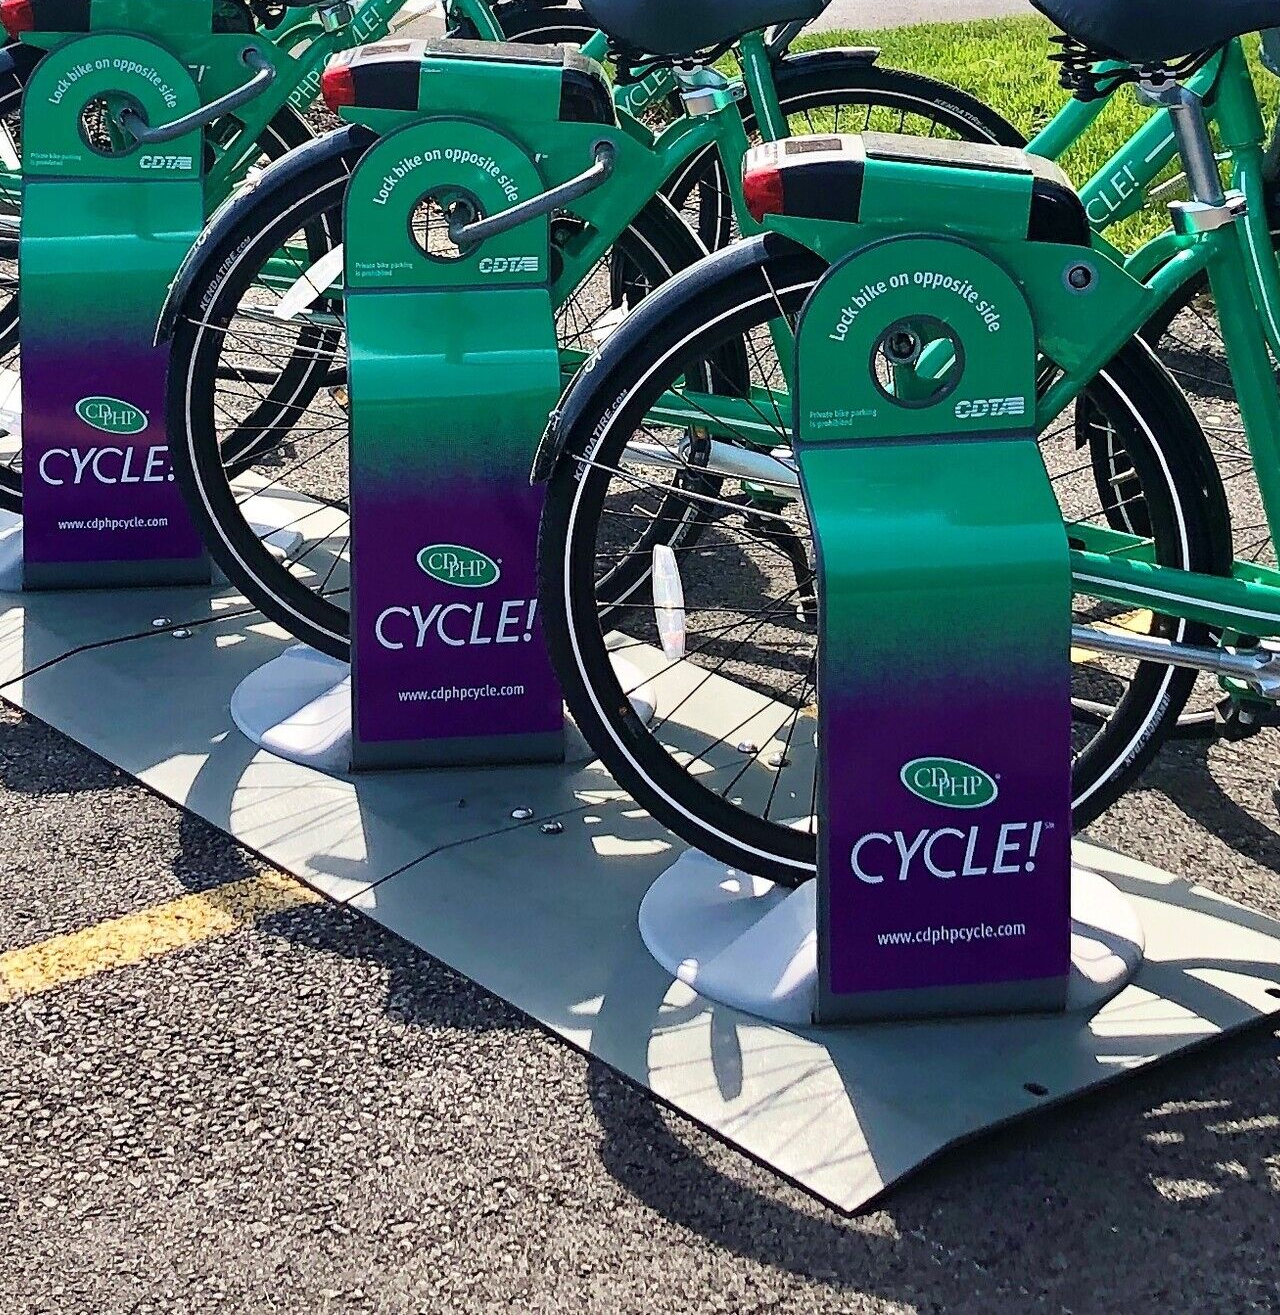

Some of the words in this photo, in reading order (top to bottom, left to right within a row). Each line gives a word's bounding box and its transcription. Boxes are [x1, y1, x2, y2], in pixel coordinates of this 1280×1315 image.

[48, 76, 71, 105] Lock
[70, 61, 94, 83] bike
[95, 58, 110, 70] on
[113, 58, 162, 86] opposite
[158, 83, 177, 109] side
[288, 70, 321, 108] PHP
[139, 155, 192, 170] CDTA
[372, 175, 398, 205] Lock
[395, 155, 422, 178] bike
[425, 148, 442, 162] on
[444, 148, 500, 179] opposite
[497, 174, 518, 202] side
[1085, 164, 1140, 223] CLE!
[479, 256, 539, 273] CDTA
[829, 303, 860, 343] Lock
[852, 280, 888, 309] bike
[889, 271, 910, 288] on
[913, 270, 980, 305] opposite
[975, 297, 1001, 333] side
[85, 403, 137, 426] CDPHP
[954, 396, 1025, 420] CDTA
[58, 516, 168, 531] www.cdphpcycle.com
[428, 552, 487, 578] CDPHP
[375, 598, 538, 650] CYCLE!
[398, 684, 525, 702] www.cdphpcycle.com
[913, 767, 983, 798] CDPHP
[850, 820, 1043, 884] CYCLE!
[877, 922, 1026, 946] www.cdphpcycle.com
